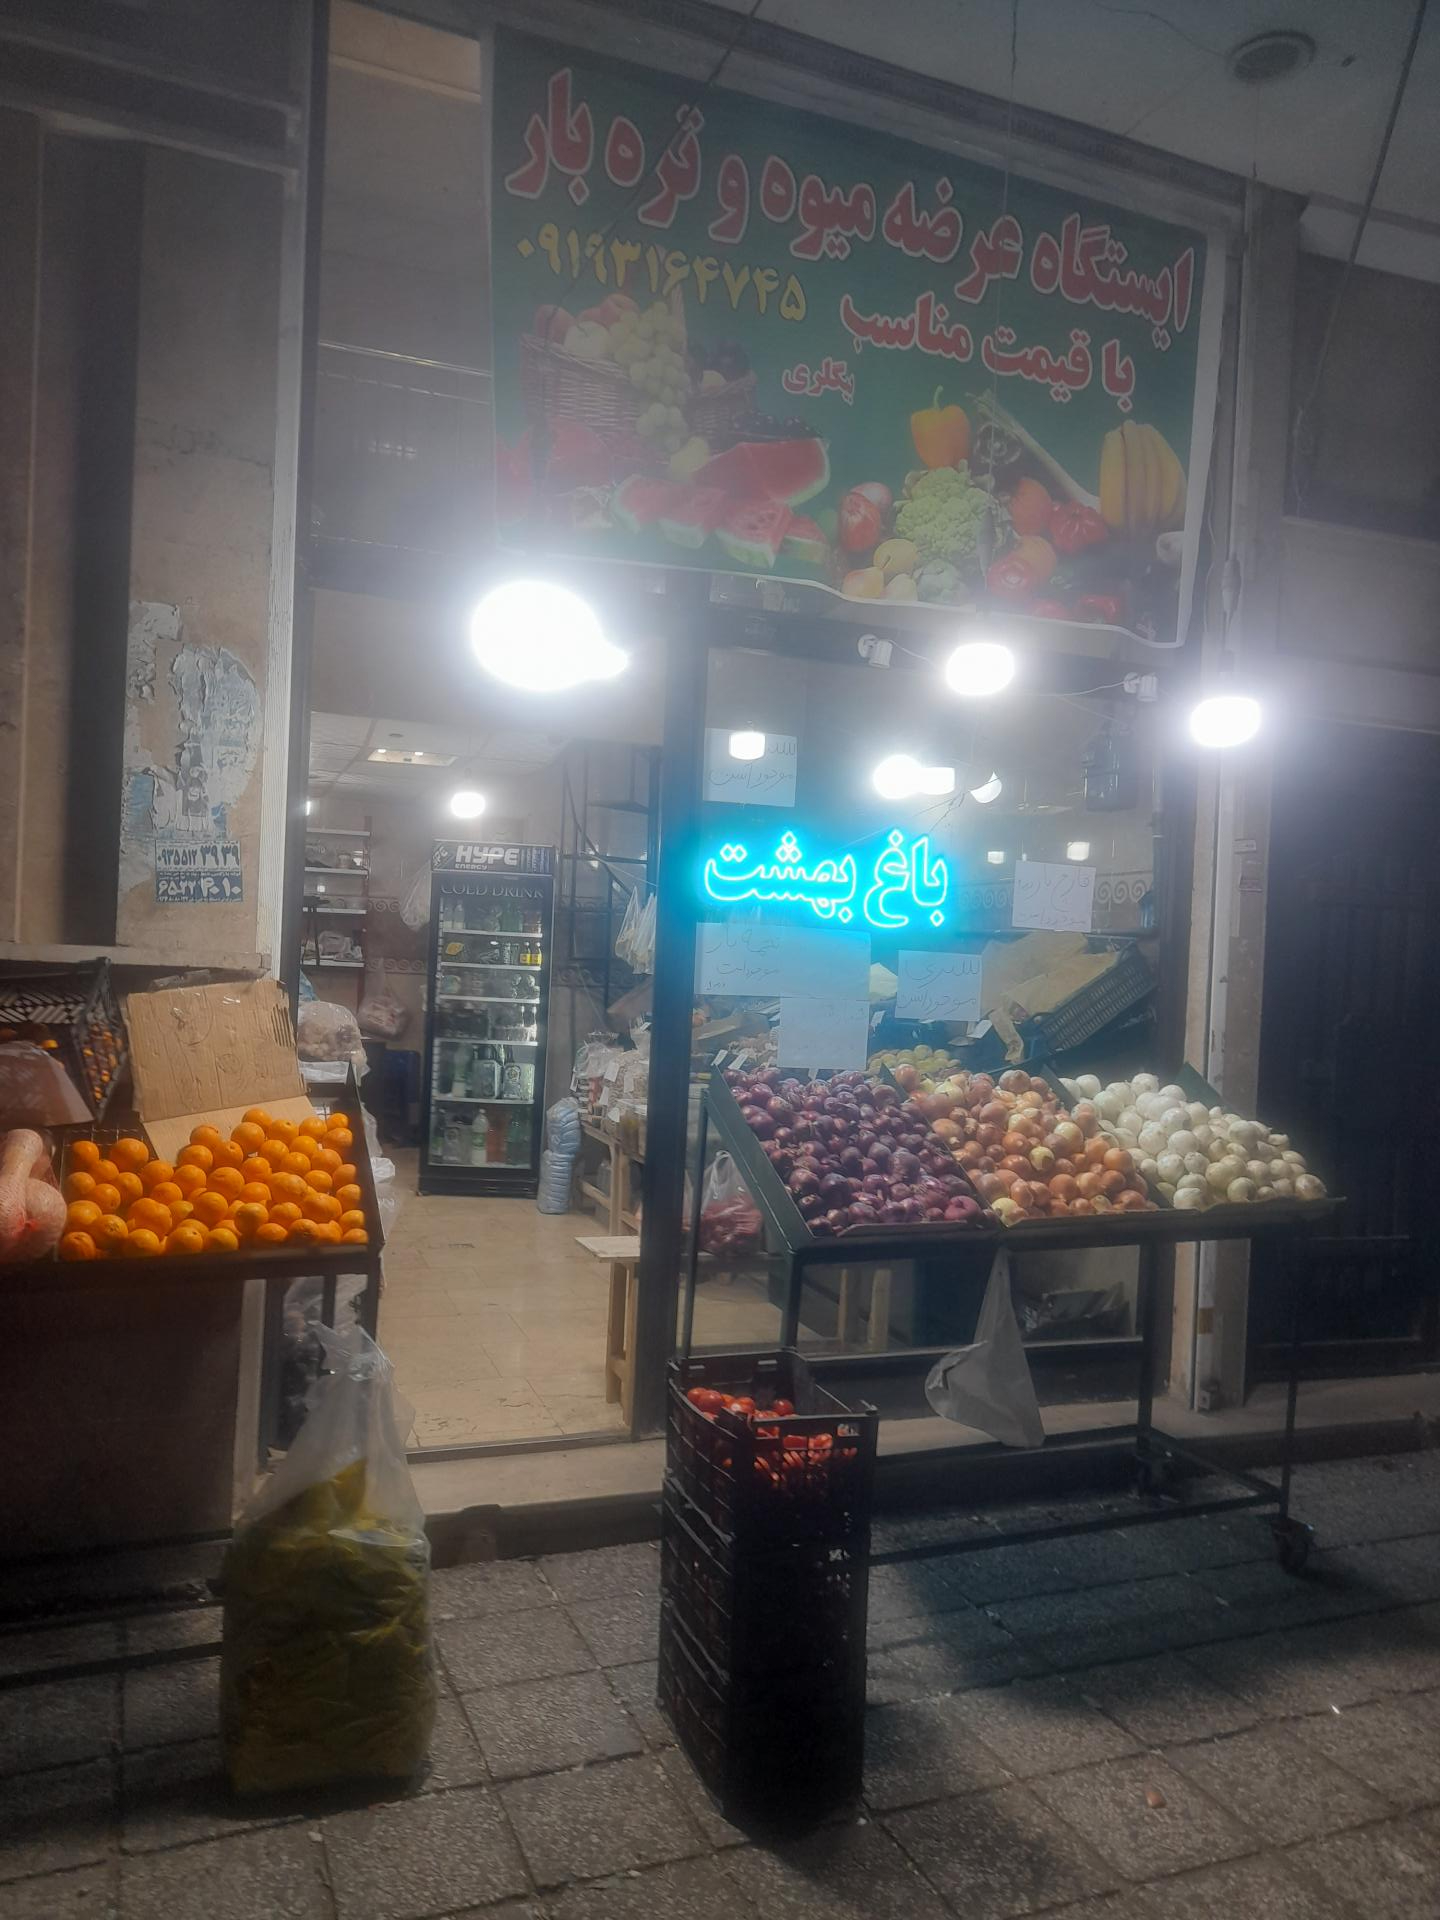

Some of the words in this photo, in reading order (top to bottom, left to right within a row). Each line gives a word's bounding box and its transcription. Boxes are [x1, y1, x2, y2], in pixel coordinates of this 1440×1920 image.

[504, 66, 594, 206] بار
[604, 103, 705, 229] تره
[708, 154, 750, 243] و
[760, 154, 876, 261] میوه
[881, 176, 1024, 304] عرضه
[839, 290, 974, 362] مناسب
[1031, 212, 1195, 351] ایستگاه
[981, 326, 1093, 403] قیمت
[1101, 338, 1136, 412] با
[440, 883, 488, 895] COLD
[491, 885, 544, 899] DRINK
[455, 845, 520, 866] HYPE
[704, 830, 857, 924] بهشت
[863, 829, 948, 928] باغ
